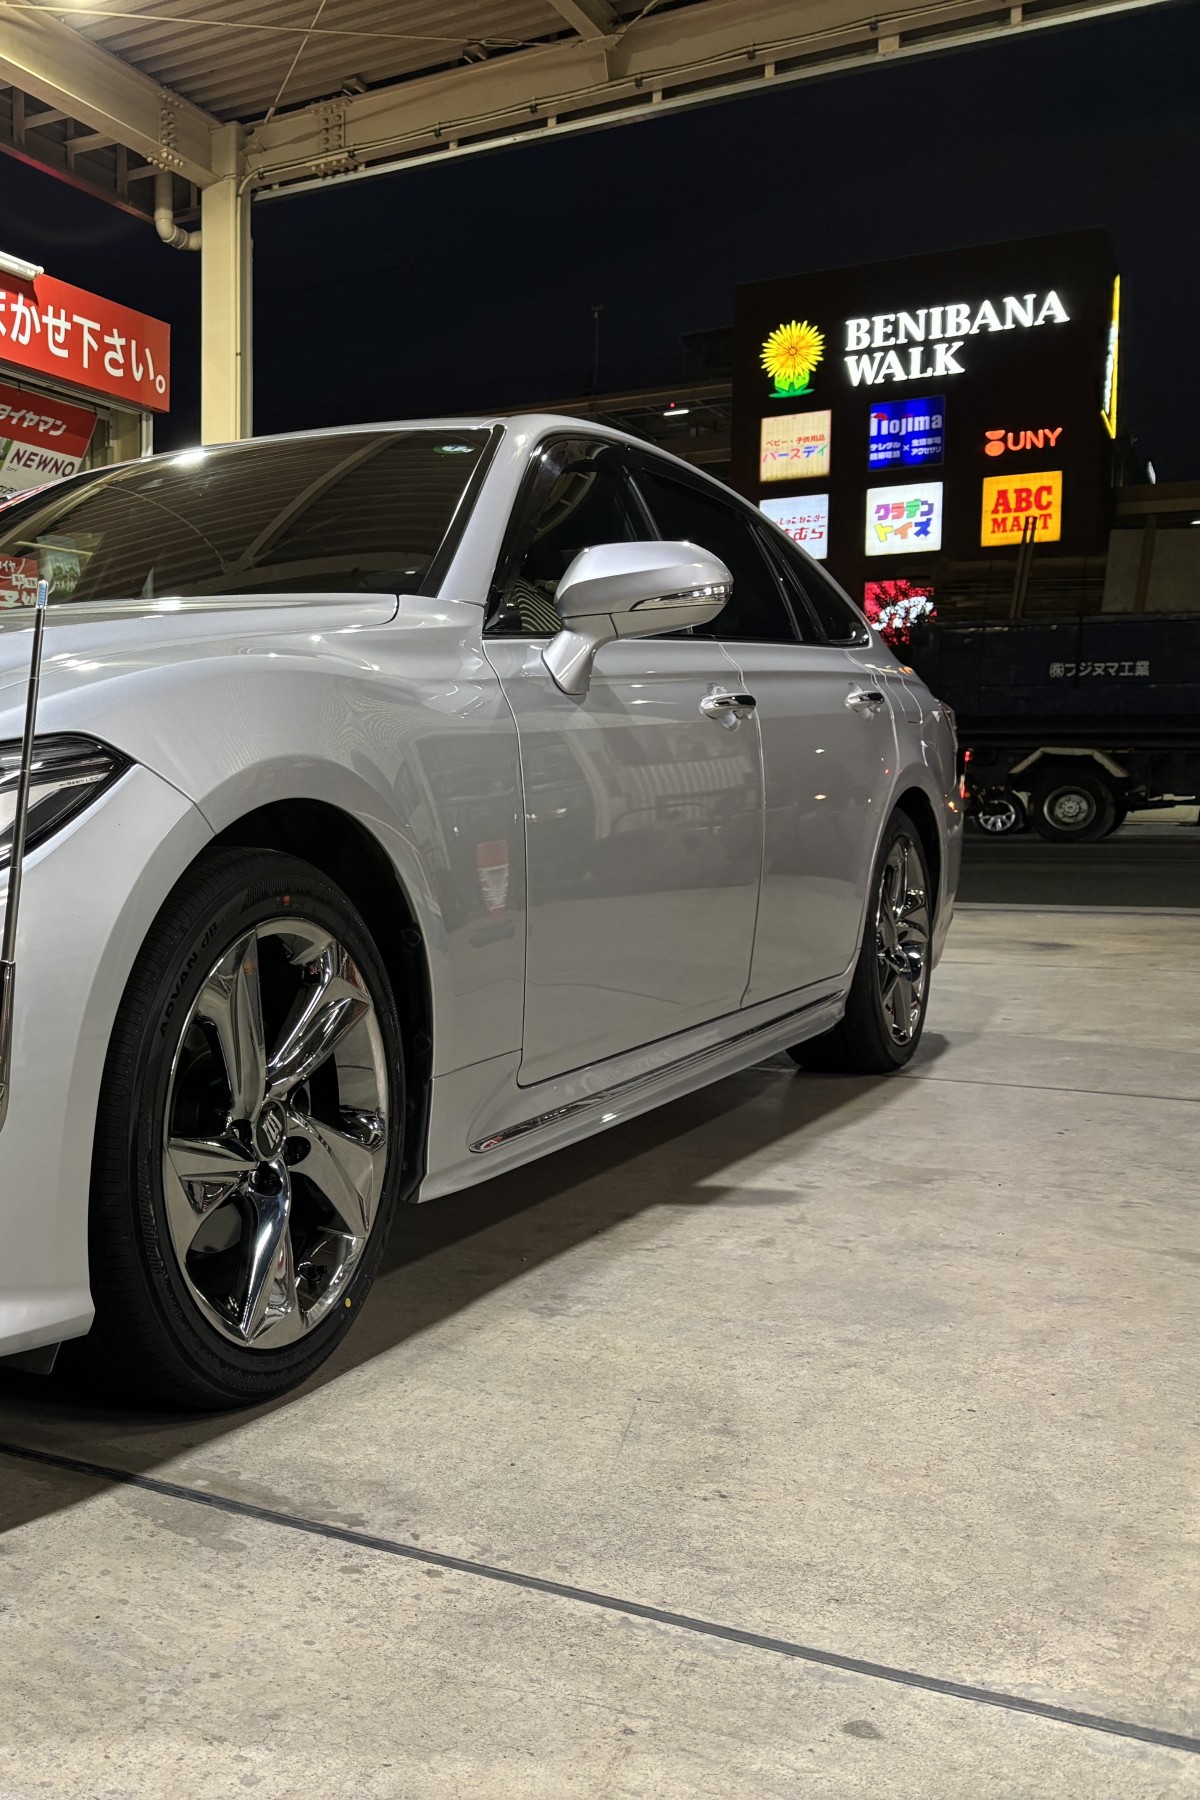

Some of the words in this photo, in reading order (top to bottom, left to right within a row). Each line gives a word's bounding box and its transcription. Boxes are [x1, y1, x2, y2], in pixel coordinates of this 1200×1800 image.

[844, 290, 1070, 351] BENIBANA
[844, 341, 966, 387] WALK
[869, 412, 942, 437] nojima
[1007, 427, 1063, 452] UNY
[10, 448, 75, 477] NEWNO
[991, 486, 1053, 514] ABC
[784, 525, 826, 541] むら
[160, 951, 199, 1037] ADVAN
